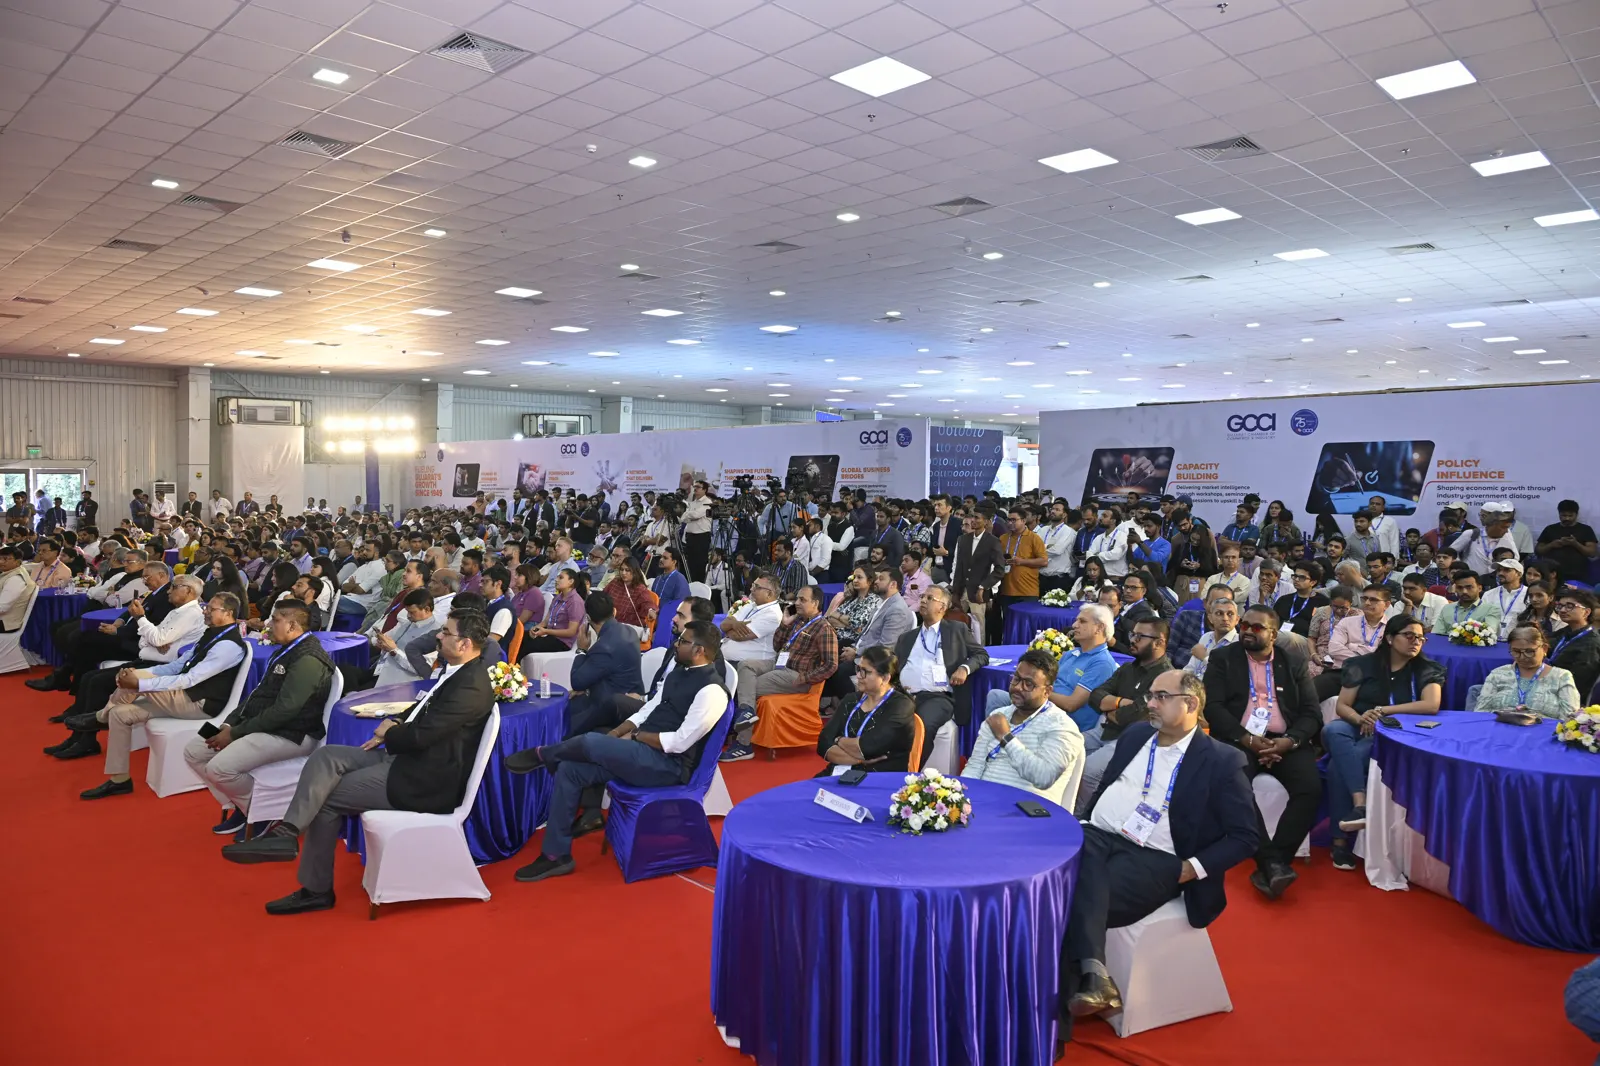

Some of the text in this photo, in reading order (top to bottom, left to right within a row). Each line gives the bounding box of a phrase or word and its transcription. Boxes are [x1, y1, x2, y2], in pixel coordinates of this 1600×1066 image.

[1226, 412, 1276, 432] GCCI
[1295, 417, 1306, 428] 75
[860, 430, 888, 444] GCCI
[560, 444, 576, 454] GCCI
[1176, 462, 1220, 470] CAPACITY
[1437, 460, 1480, 468] POLICY
[1437, 471, 1505, 479] INFLUENCE
